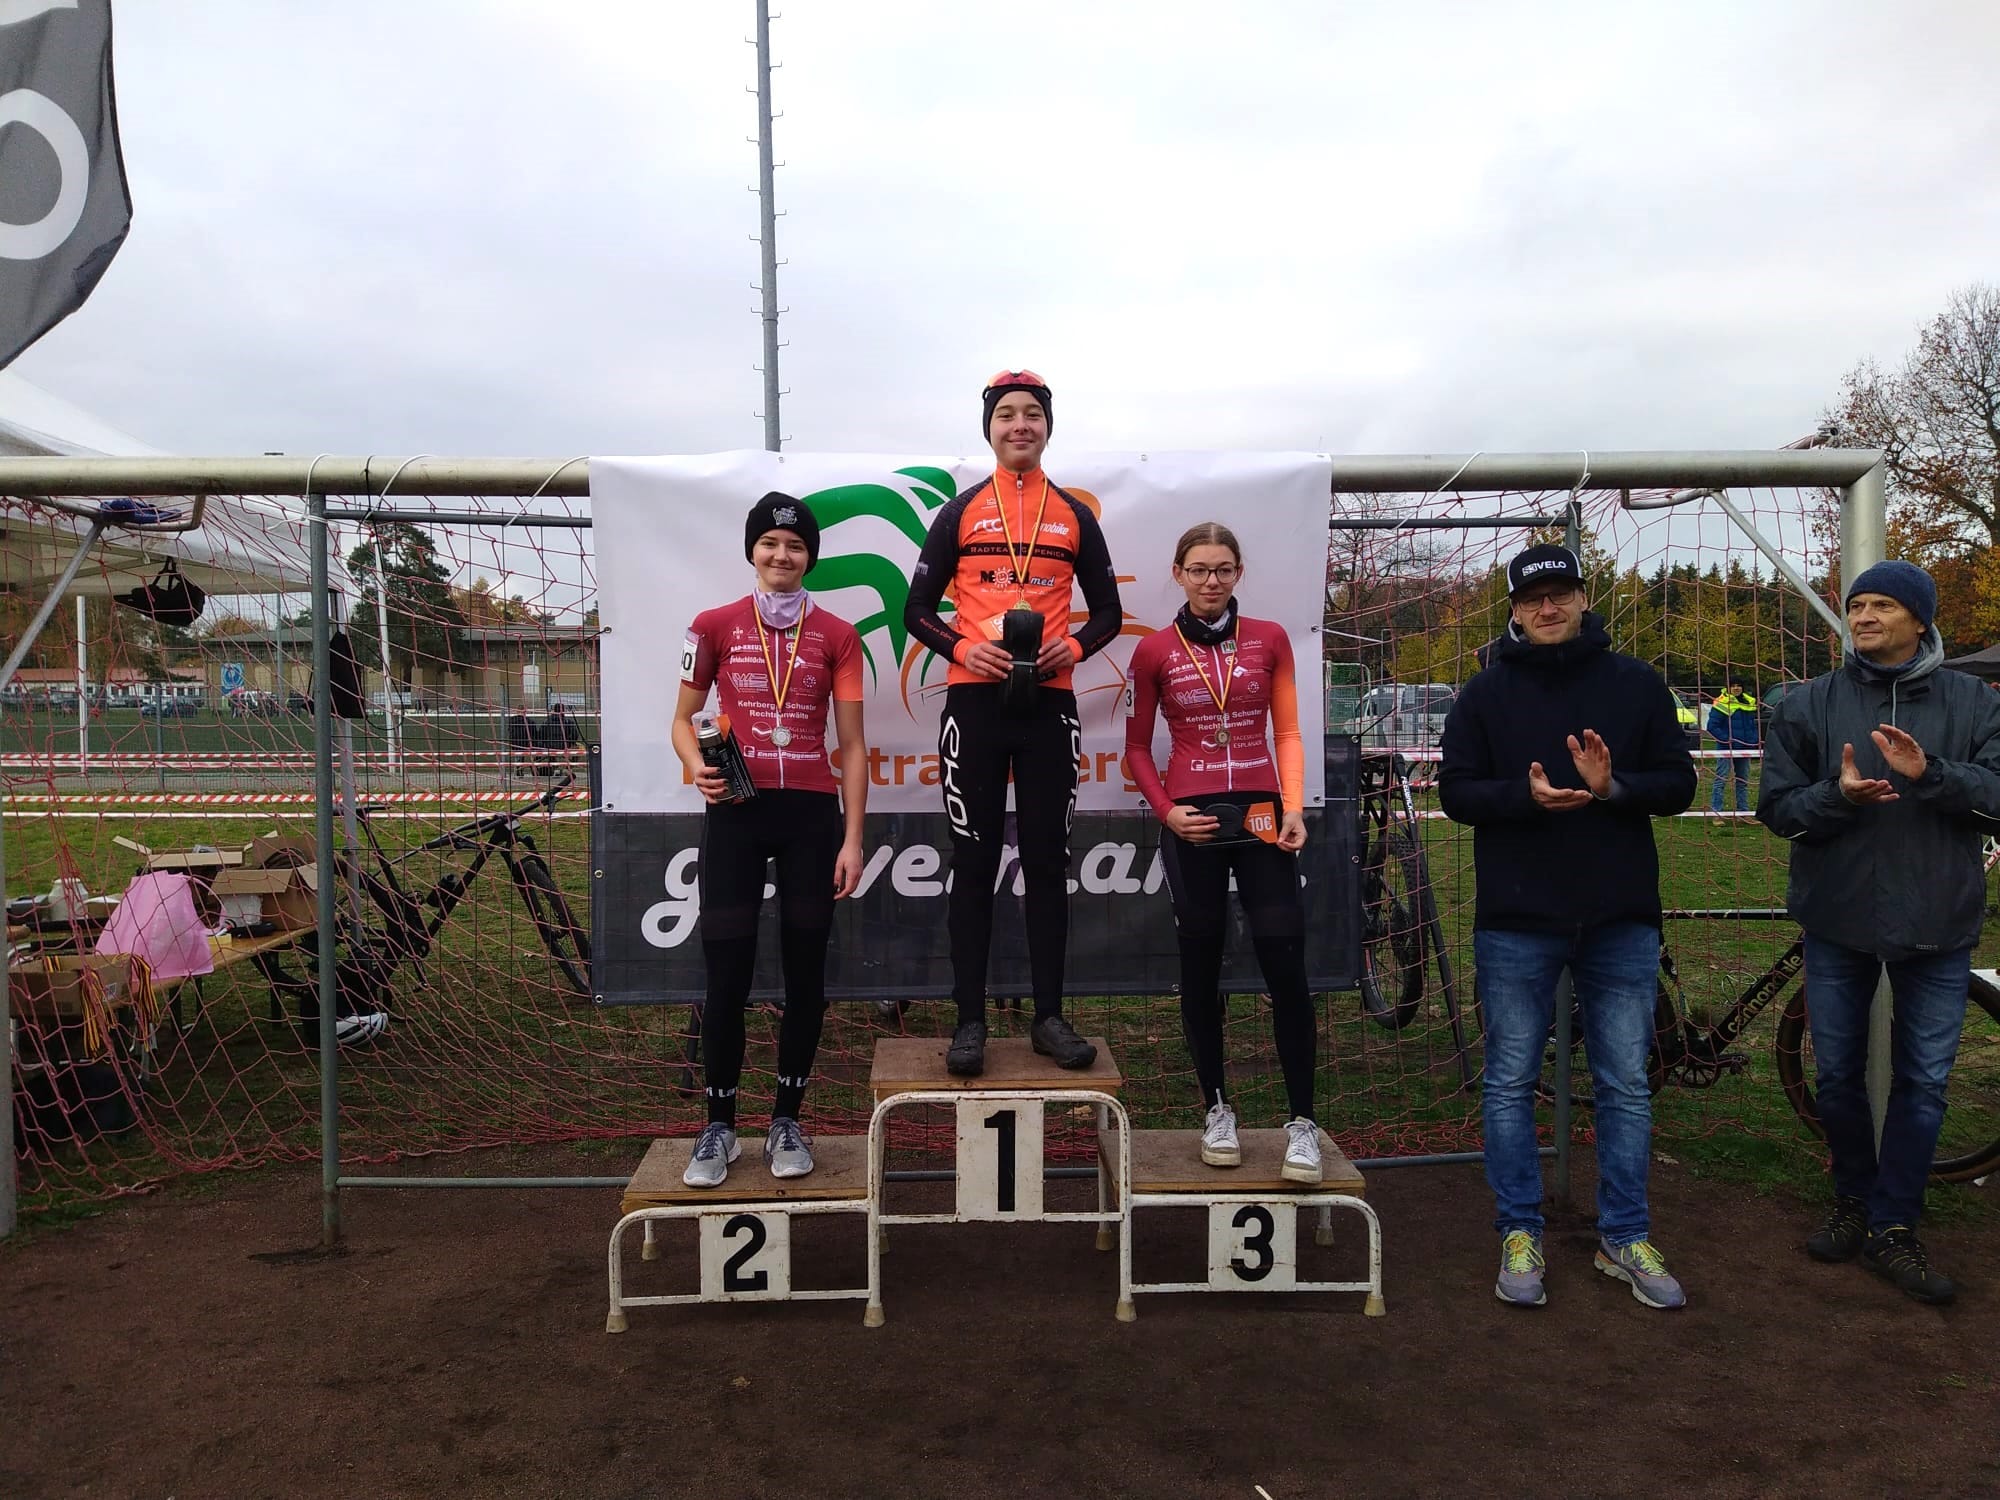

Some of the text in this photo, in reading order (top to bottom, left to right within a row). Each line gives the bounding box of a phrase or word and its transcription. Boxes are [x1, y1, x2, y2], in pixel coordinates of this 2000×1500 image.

[738, 701, 776, 710] Kehrberg
[1186, 713, 1222, 723] Kehrberg
[1198, 719, 1254, 730] Rechtanwälte
[1248, 816, 1273, 832] 10€
[984, 1110, 1016, 1212] 1
[1231, 1205, 1275, 1282] 3
[723, 1214, 768, 1292] 2
